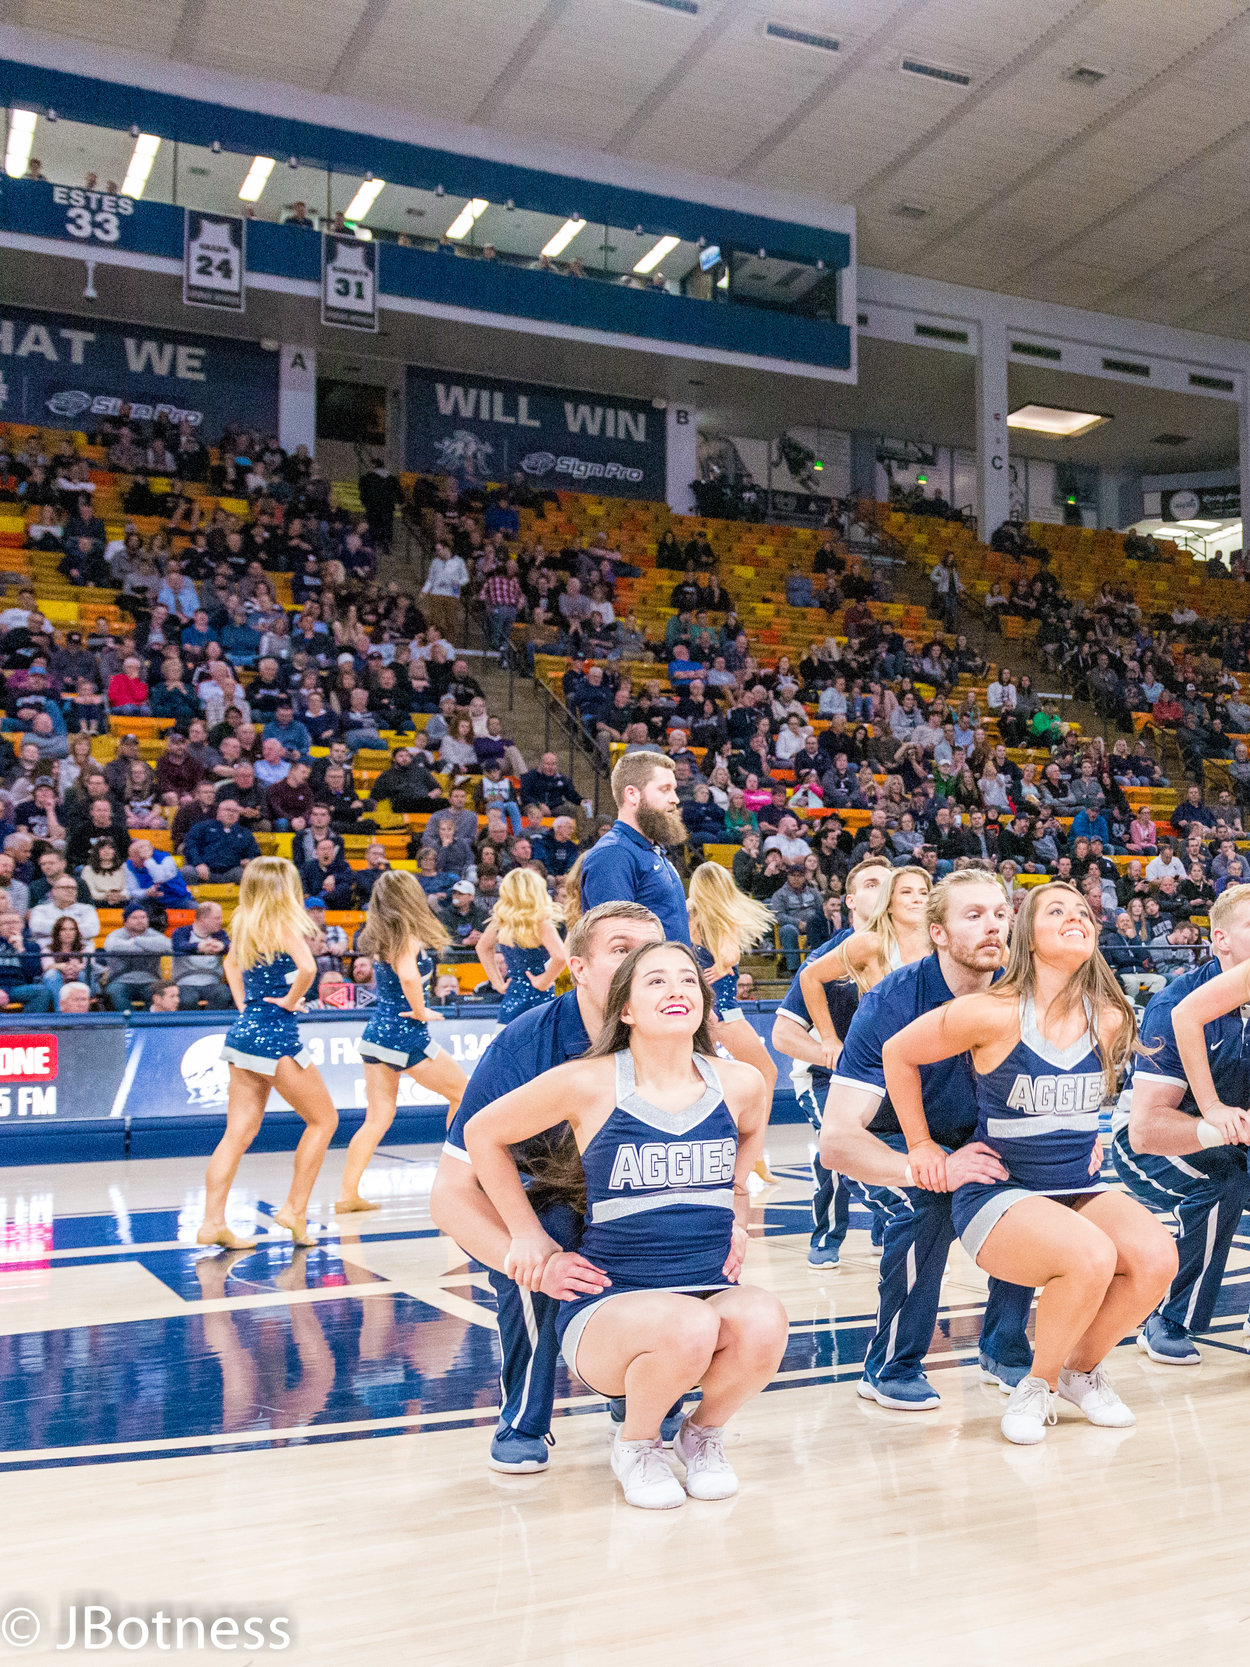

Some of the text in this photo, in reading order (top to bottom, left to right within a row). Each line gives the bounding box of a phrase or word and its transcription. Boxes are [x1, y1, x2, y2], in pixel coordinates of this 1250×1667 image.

[53, 186, 134, 215] ESTES
[65, 206, 121, 243] 33
[196, 255, 233, 280] 24
[335, 278, 366, 300] 31
[123, 338, 207, 382] WE
[290, 352, 307, 371] A
[434, 382, 648, 442] WILL WIN
[675, 409, 689, 425] B
[991, 455, 1003, 470] C
[0, 1047, 50, 1075] ONE
[18, 1086, 57, 1116] FM
[1006, 1071, 1107, 1115] AGGIE
[608, 1137, 737, 1190] AGGIES
